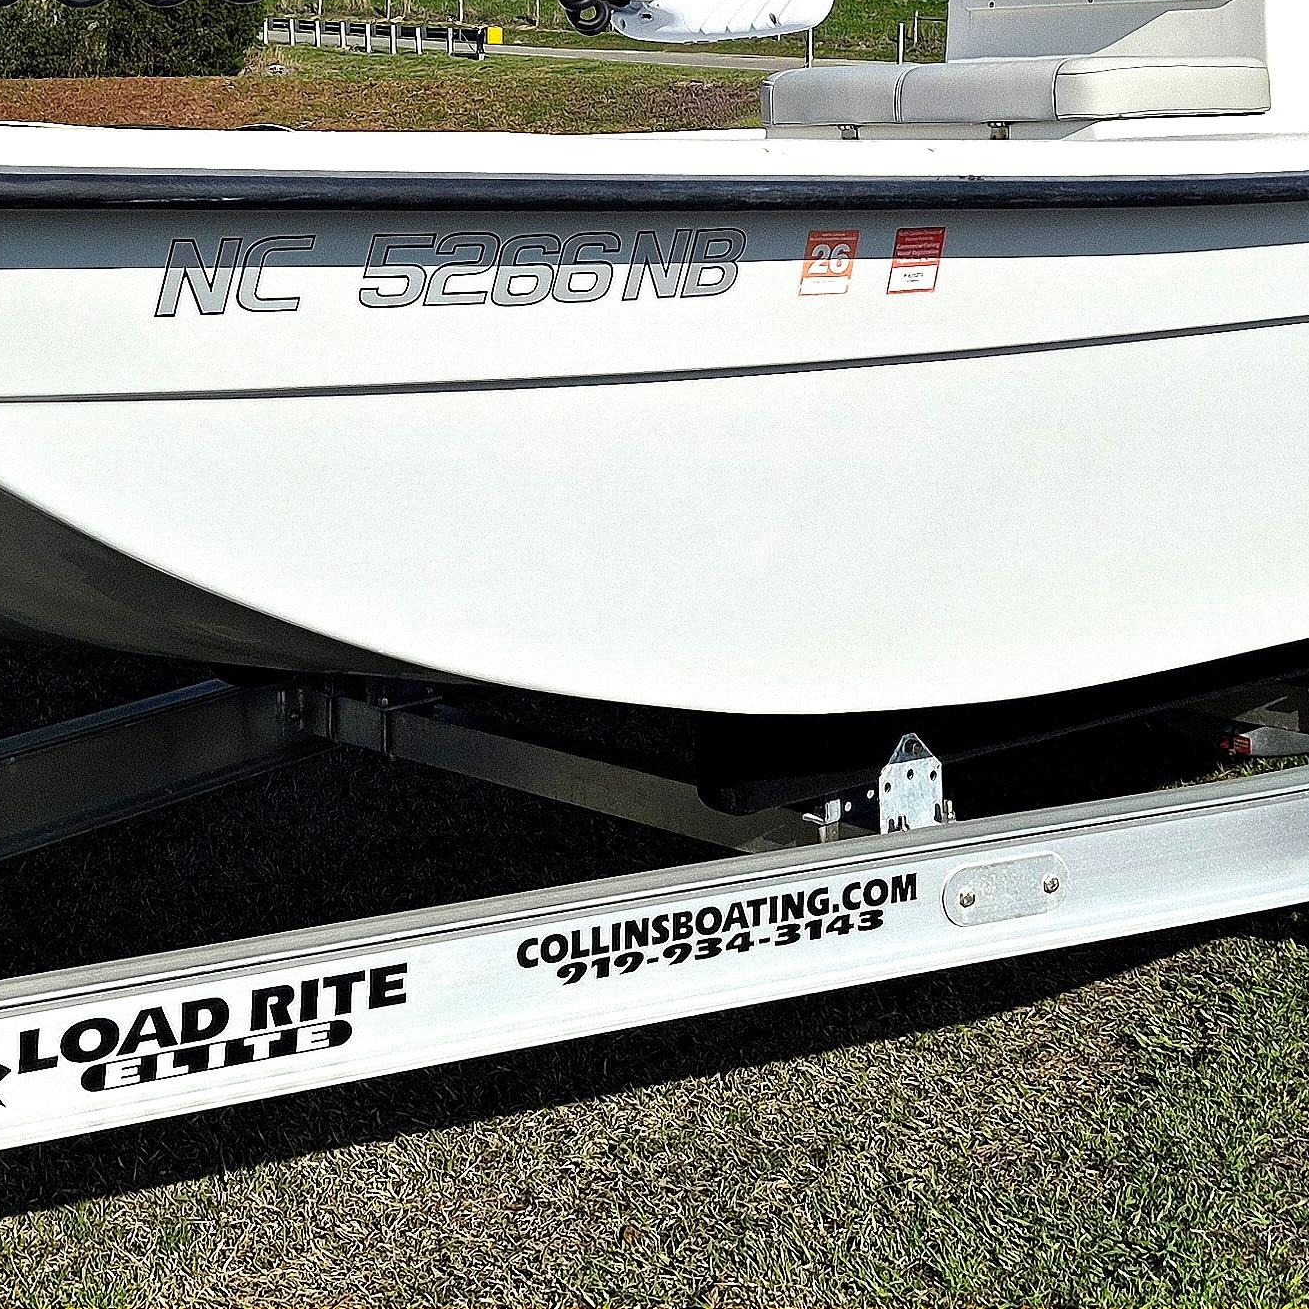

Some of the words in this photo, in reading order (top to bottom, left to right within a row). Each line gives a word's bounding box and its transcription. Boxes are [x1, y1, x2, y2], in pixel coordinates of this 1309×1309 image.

[154, 234, 316, 317] NC
[807, 243, 851, 275] 26
[516, 872, 918, 969] COLLINSBOATING.COM
[556, 908, 885, 986] 919-934-3143
[18, 997, 230, 1074] LOAD
[250, 962, 408, 1032] RITE
[100, 1021, 333, 1090] ELITE
